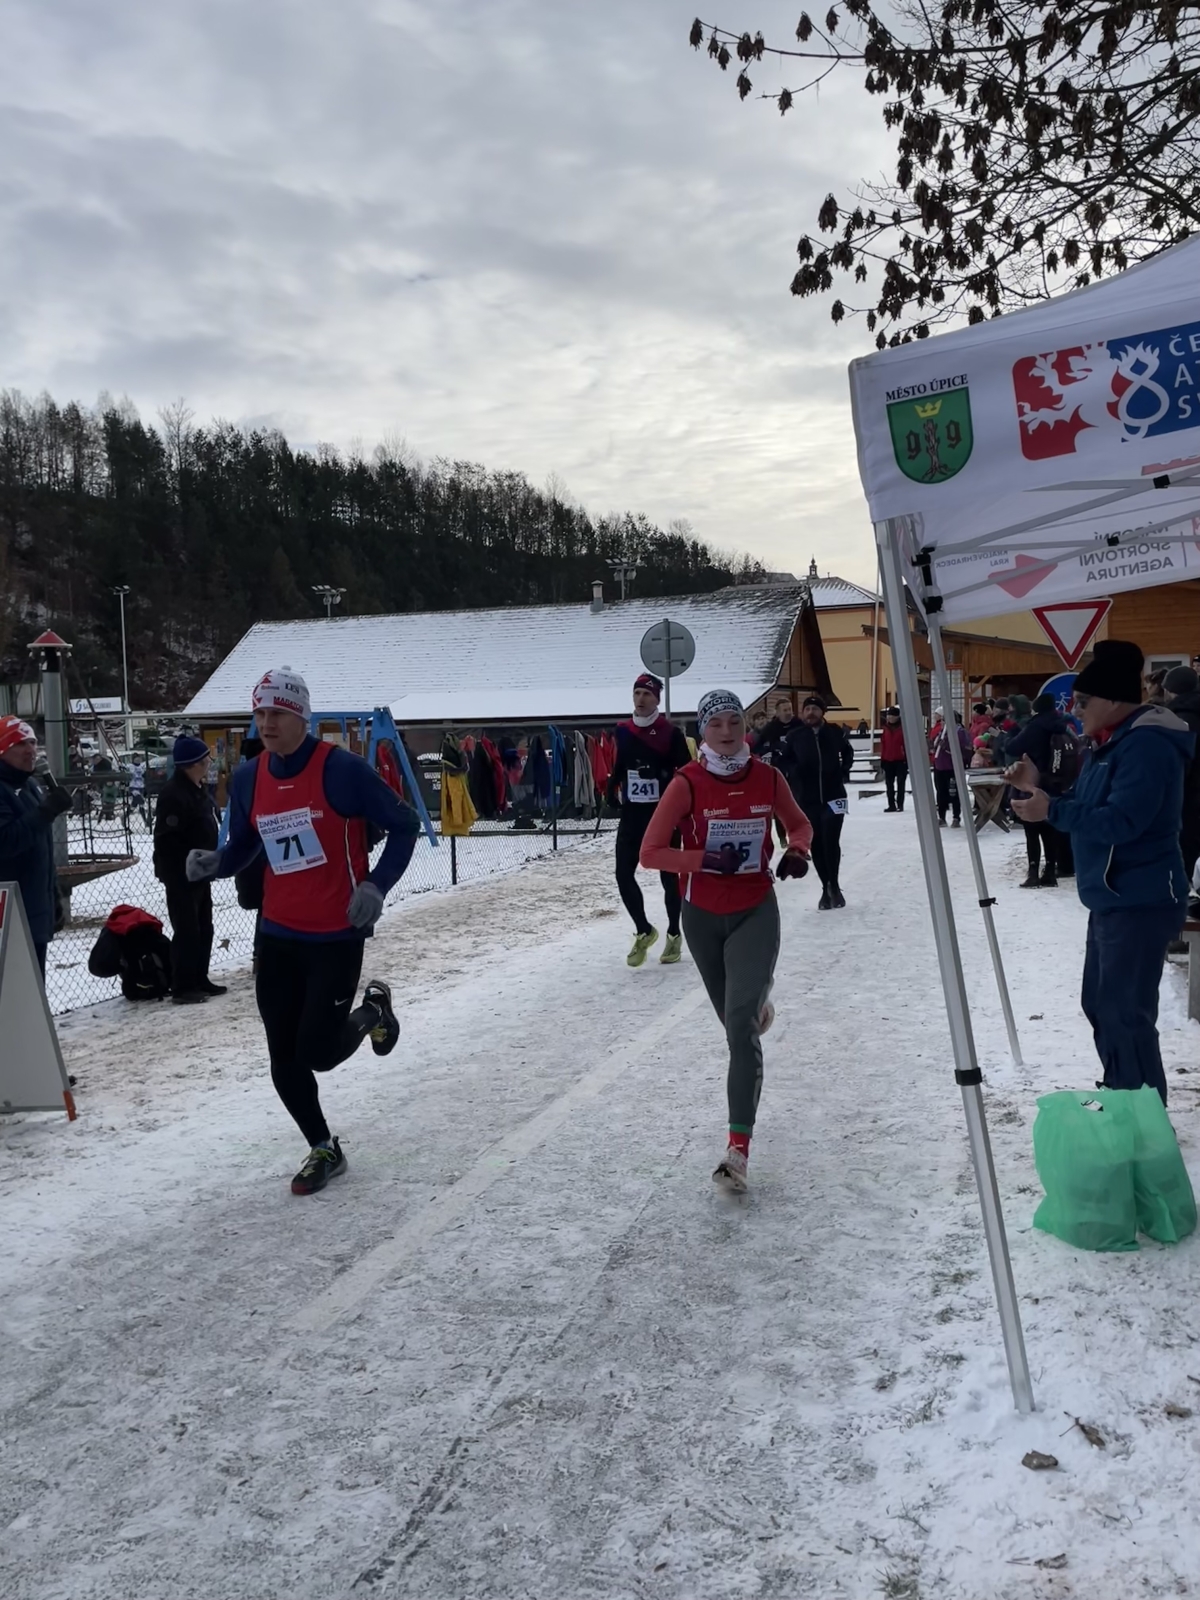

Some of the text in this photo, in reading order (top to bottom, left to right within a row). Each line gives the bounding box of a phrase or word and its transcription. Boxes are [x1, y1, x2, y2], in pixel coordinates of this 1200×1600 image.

[886, 373, 968, 402] MĚSTO ÚPICE
[1174, 360, 1200, 388] A
[631, 782, 654, 796] 241
[711, 822, 736, 830] ZIMNÍ
[275, 834, 305, 861] 71
